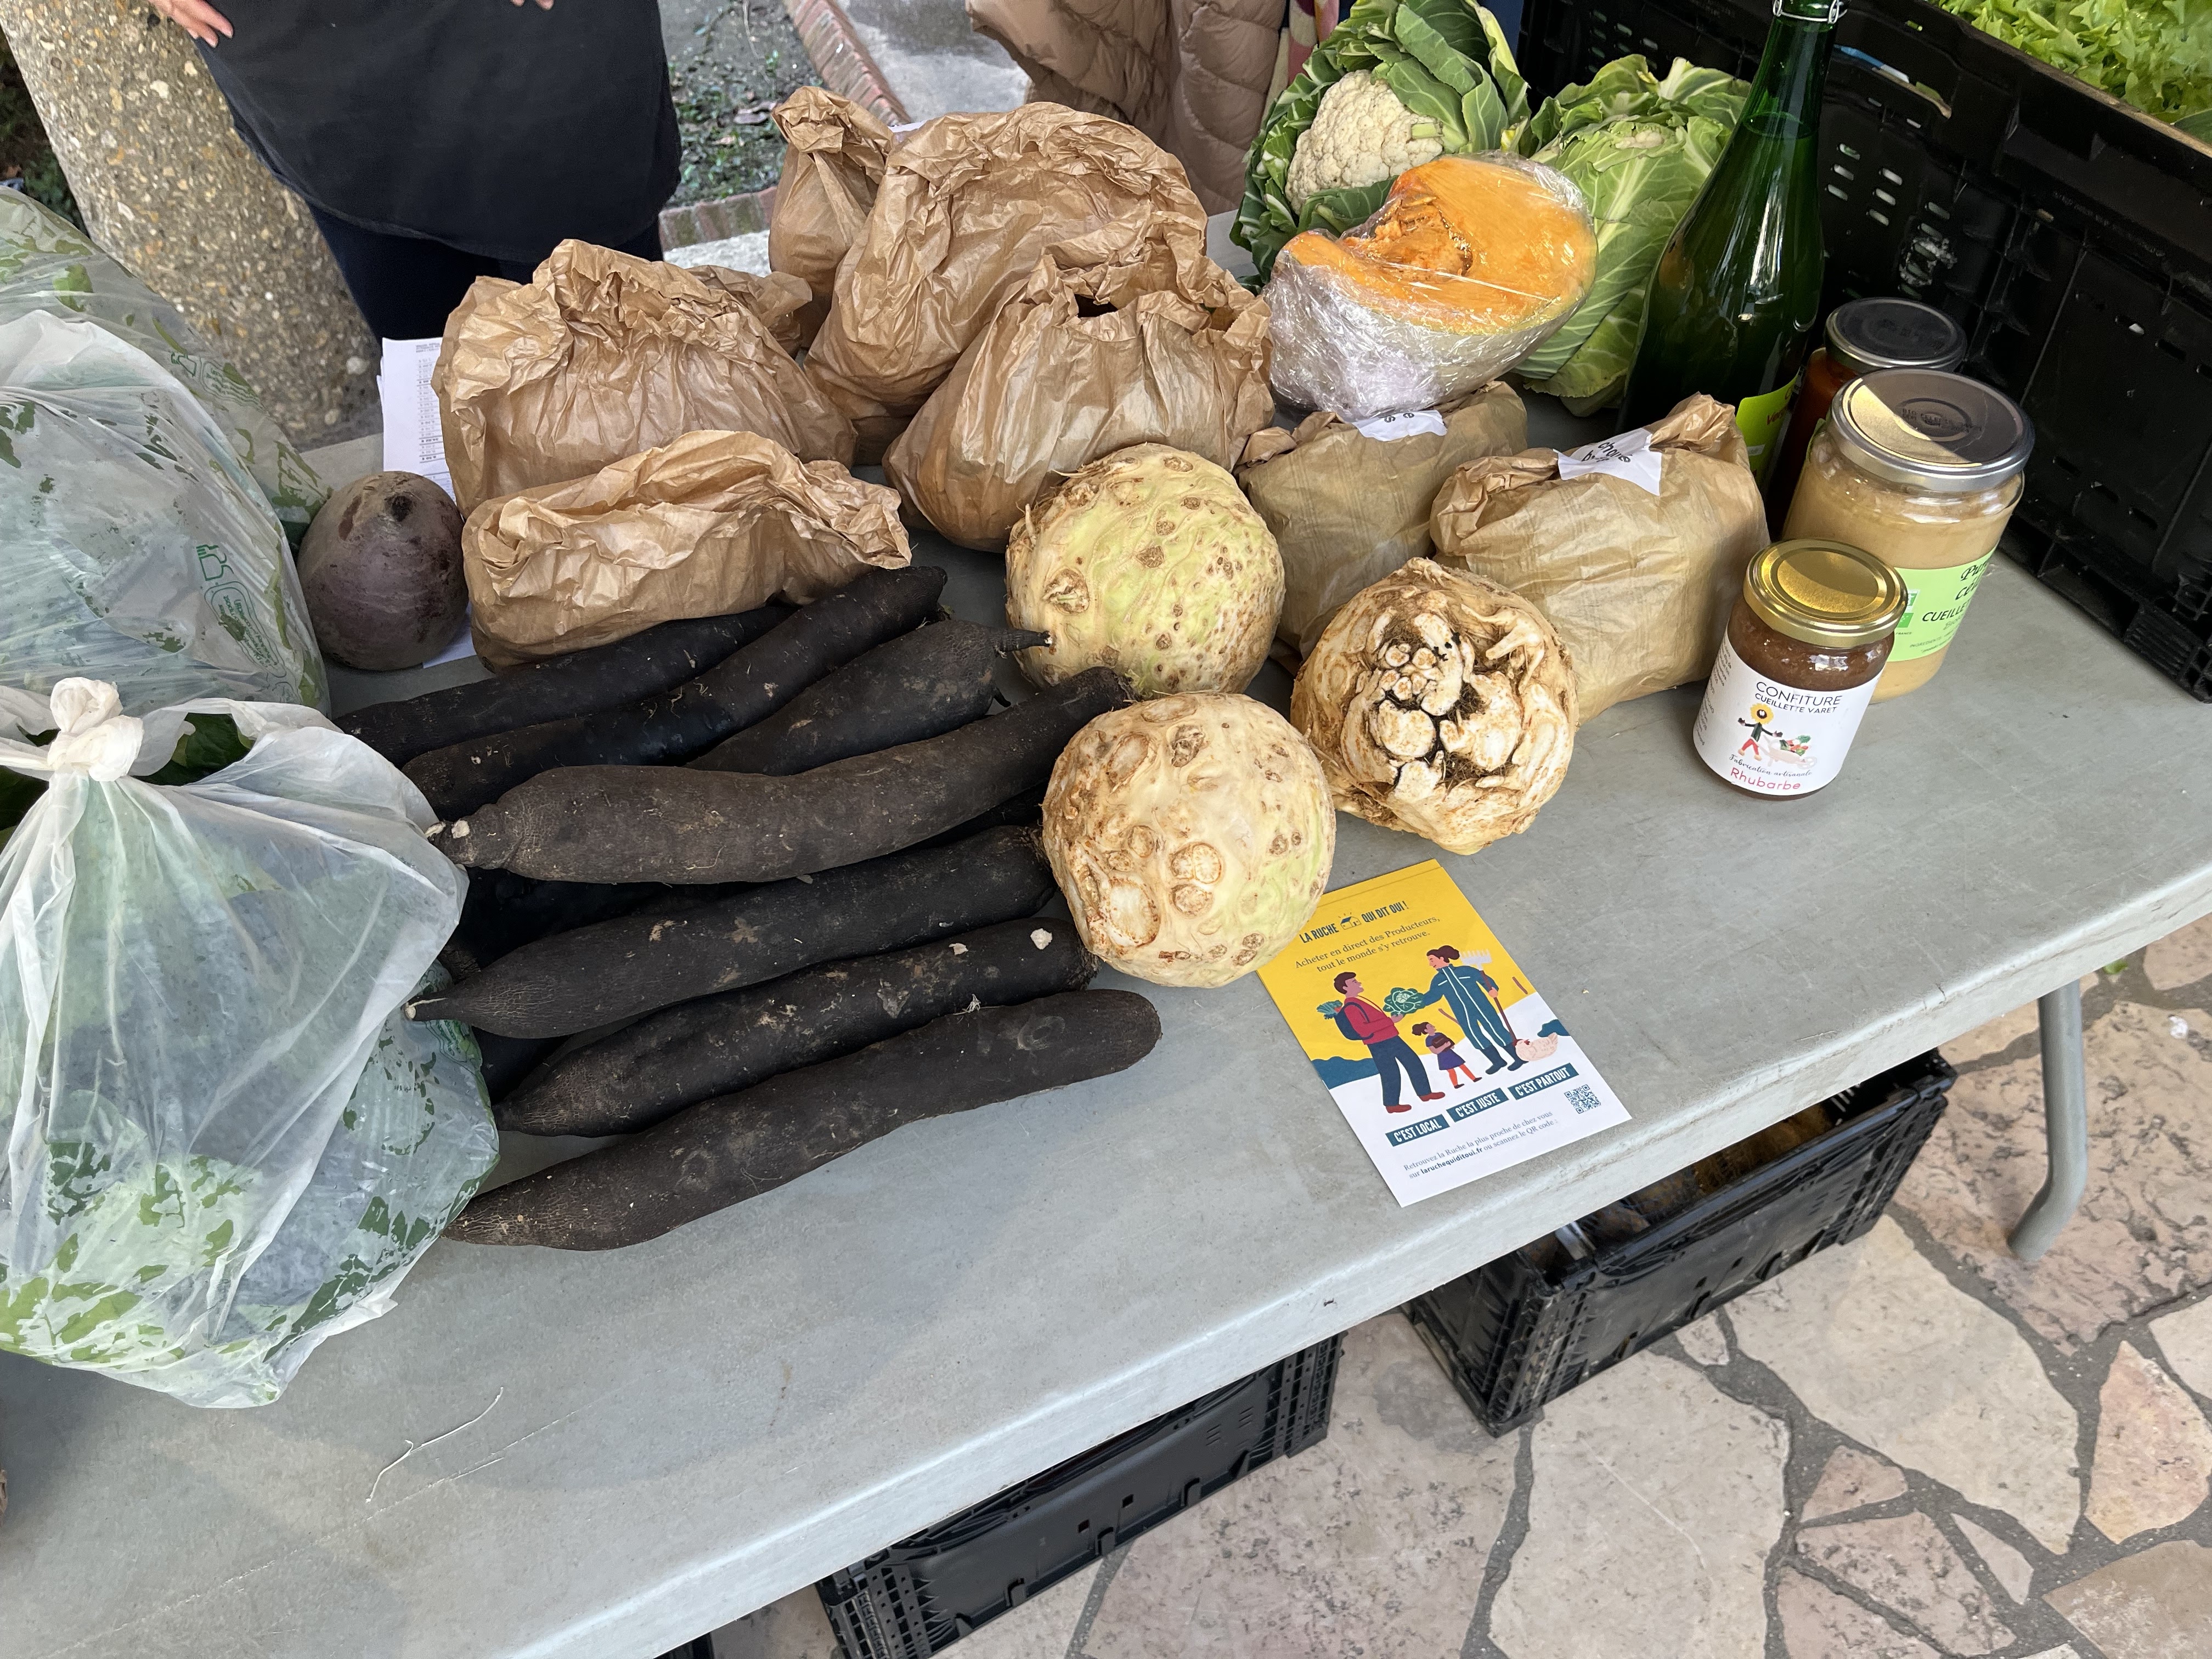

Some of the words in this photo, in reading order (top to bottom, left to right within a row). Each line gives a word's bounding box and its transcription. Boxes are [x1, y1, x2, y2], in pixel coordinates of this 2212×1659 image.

[1755, 693, 1805, 713] CUEILLETTE
[1756, 681, 1843, 706] CONFITURE
[1729, 754, 1772, 775] Fabrication
[1730, 767, 1801, 790] Rhubarbe
[1299, 933, 1313, 944] LA
[1310, 923, 1339, 940] RUCHE
[1361, 911, 1378, 923] QUI
[1375, 906, 1390, 918] DIT
[1295, 952, 1331, 969] Acheter
[1330, 949, 1341, 957] en
[1342, 939, 1368, 953] direct
[1369, 933, 1385, 943] des
[1385, 916, 1440, 938] Producteurs,
[1317, 962, 1337, 973] tout
[1336, 958, 1346, 967] le
[1346, 947, 1377, 963] monde
[1391, 930, 1431, 948] retrouve.
[1515, 1080, 1539, 1097] C'EST
[1535, 1066, 1571, 1088] PARTOUT
[1455, 1102, 1481, 1118] C'EST
[1479, 1092, 1501, 1109] JUSTE
[1393, 1126, 1419, 1143] C'EST
[1417, 1118, 1443, 1133] LOCAL
[1403, 1155, 1438, 1171] Retrouvez
[1444, 1144, 1467, 1156] Ruche
[1474, 1136, 1489, 1146] plus
[1489, 1126, 1513, 1140] proche
[1522, 1118, 1537, 1127] chez
[1537, 1111, 1553, 1120] vous
[1409, 1170, 1421, 1179] sur
[1420, 1147, 1483, 1175] laruchequiditoui.fr
[1493, 1134, 1520, 1147] scannez
[1526, 1125, 1538, 1135] QR
[1538, 1119, 1554, 1130] code
